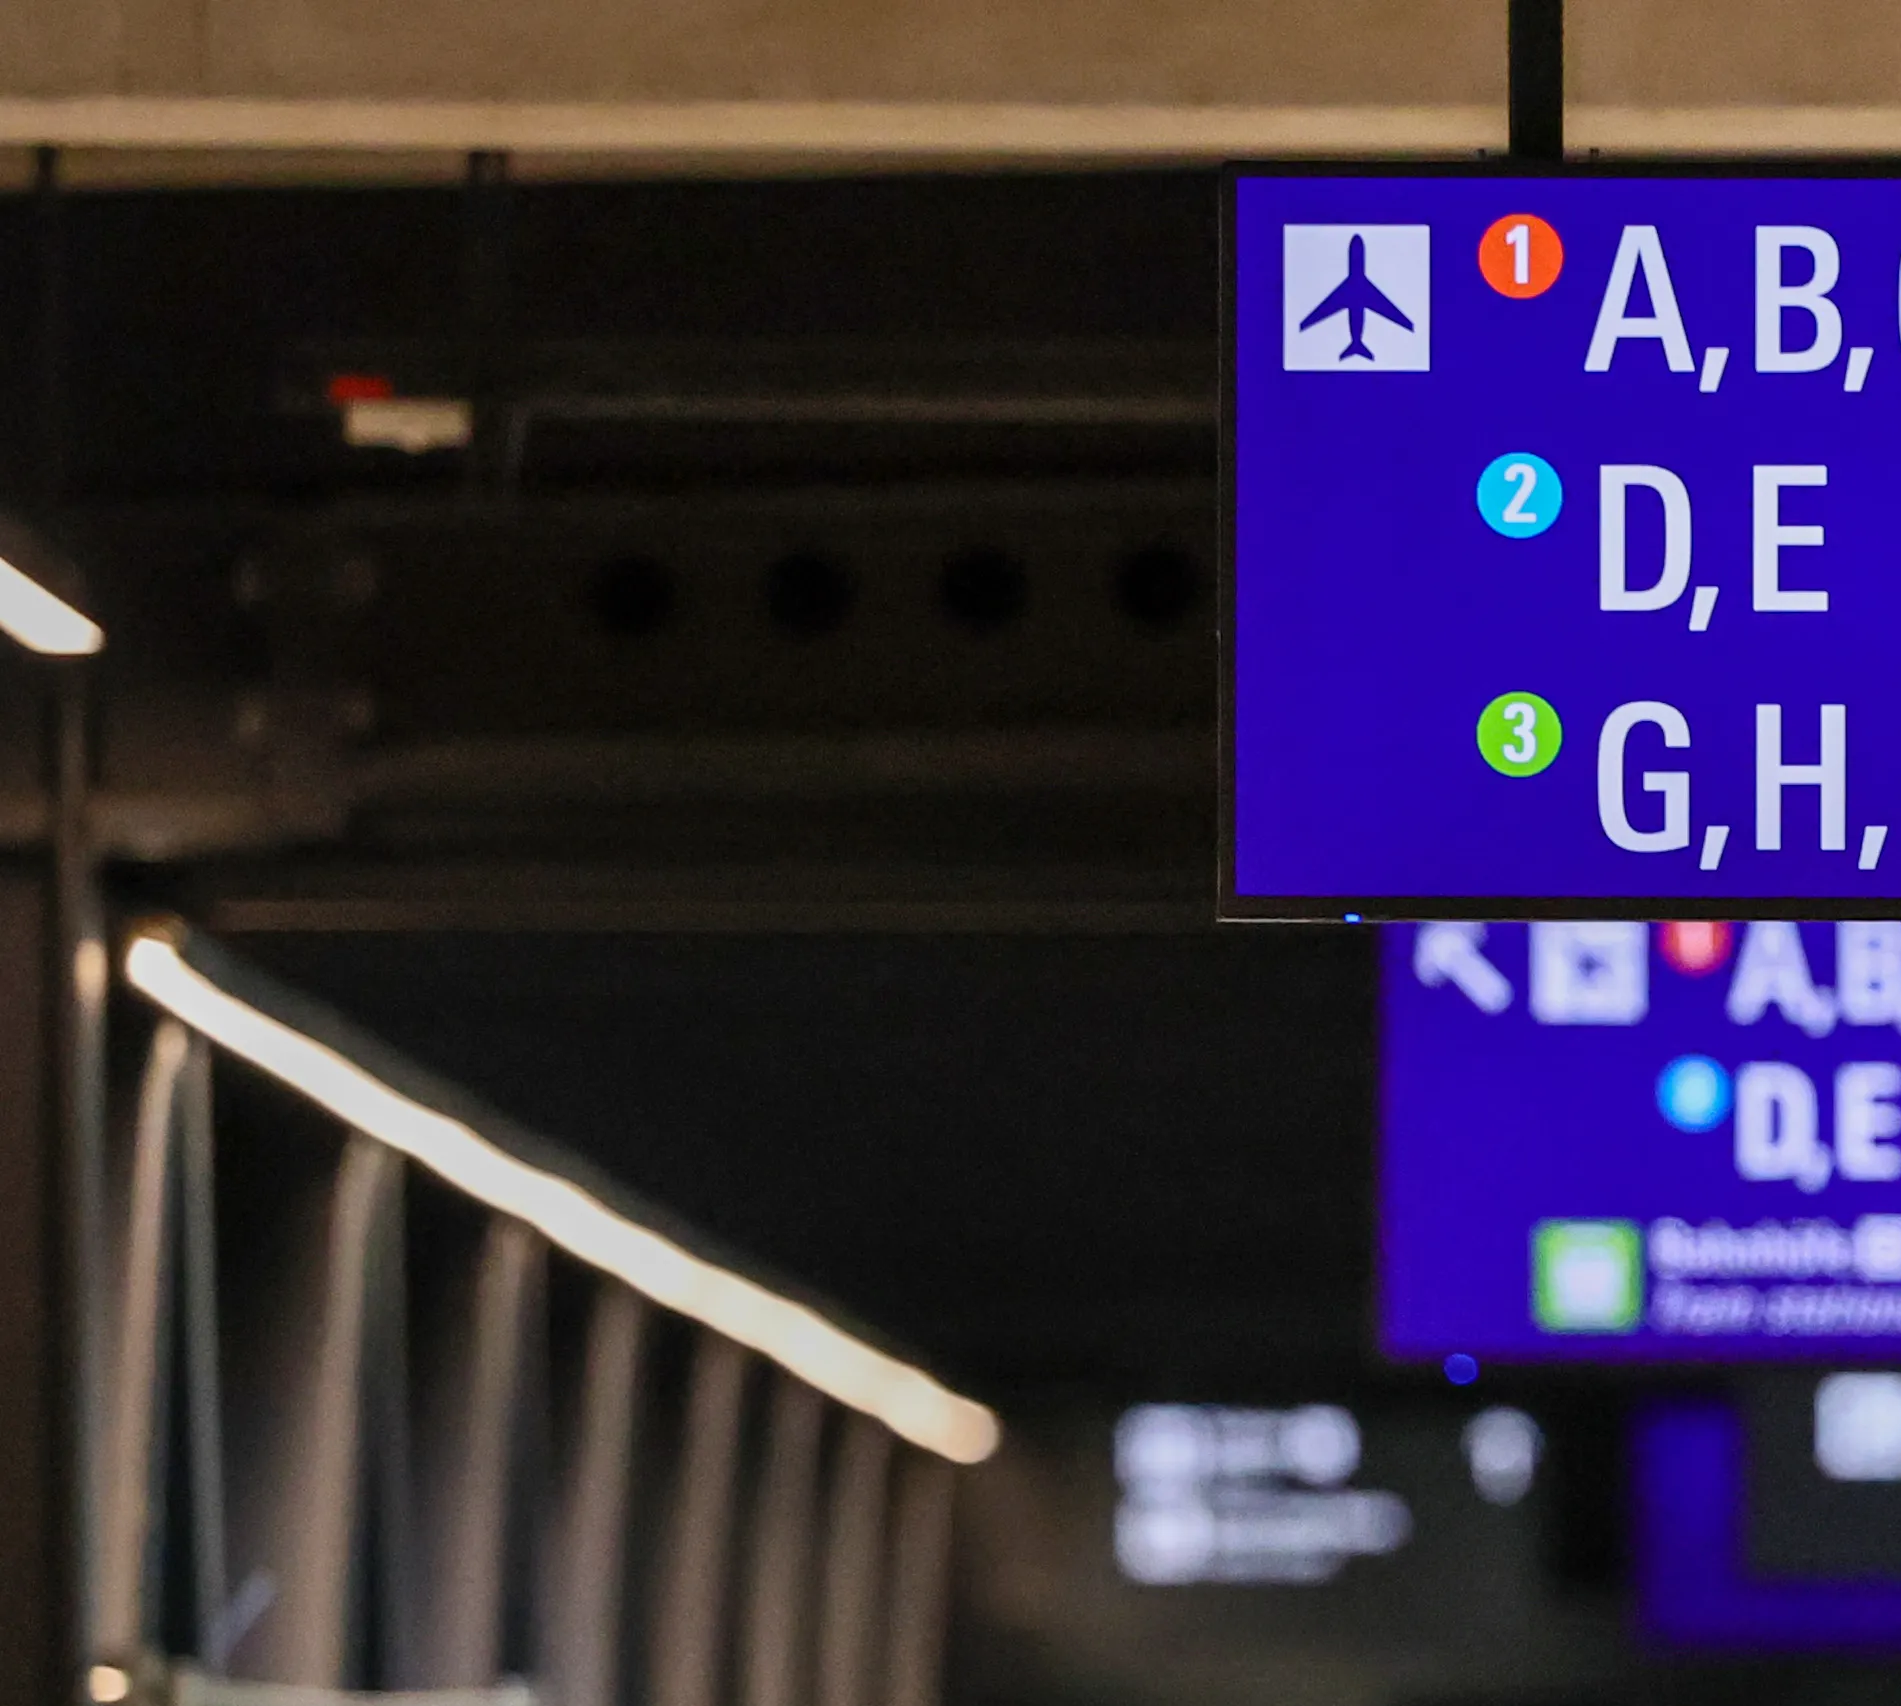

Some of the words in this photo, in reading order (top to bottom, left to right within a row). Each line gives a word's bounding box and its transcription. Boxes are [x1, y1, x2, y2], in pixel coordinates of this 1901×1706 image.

[1508, 225, 1530, 285] 1
[1504, 461, 1537, 525] 2
[1600, 464, 1829, 632] D,E
[1502, 701, 1537, 765] 3
